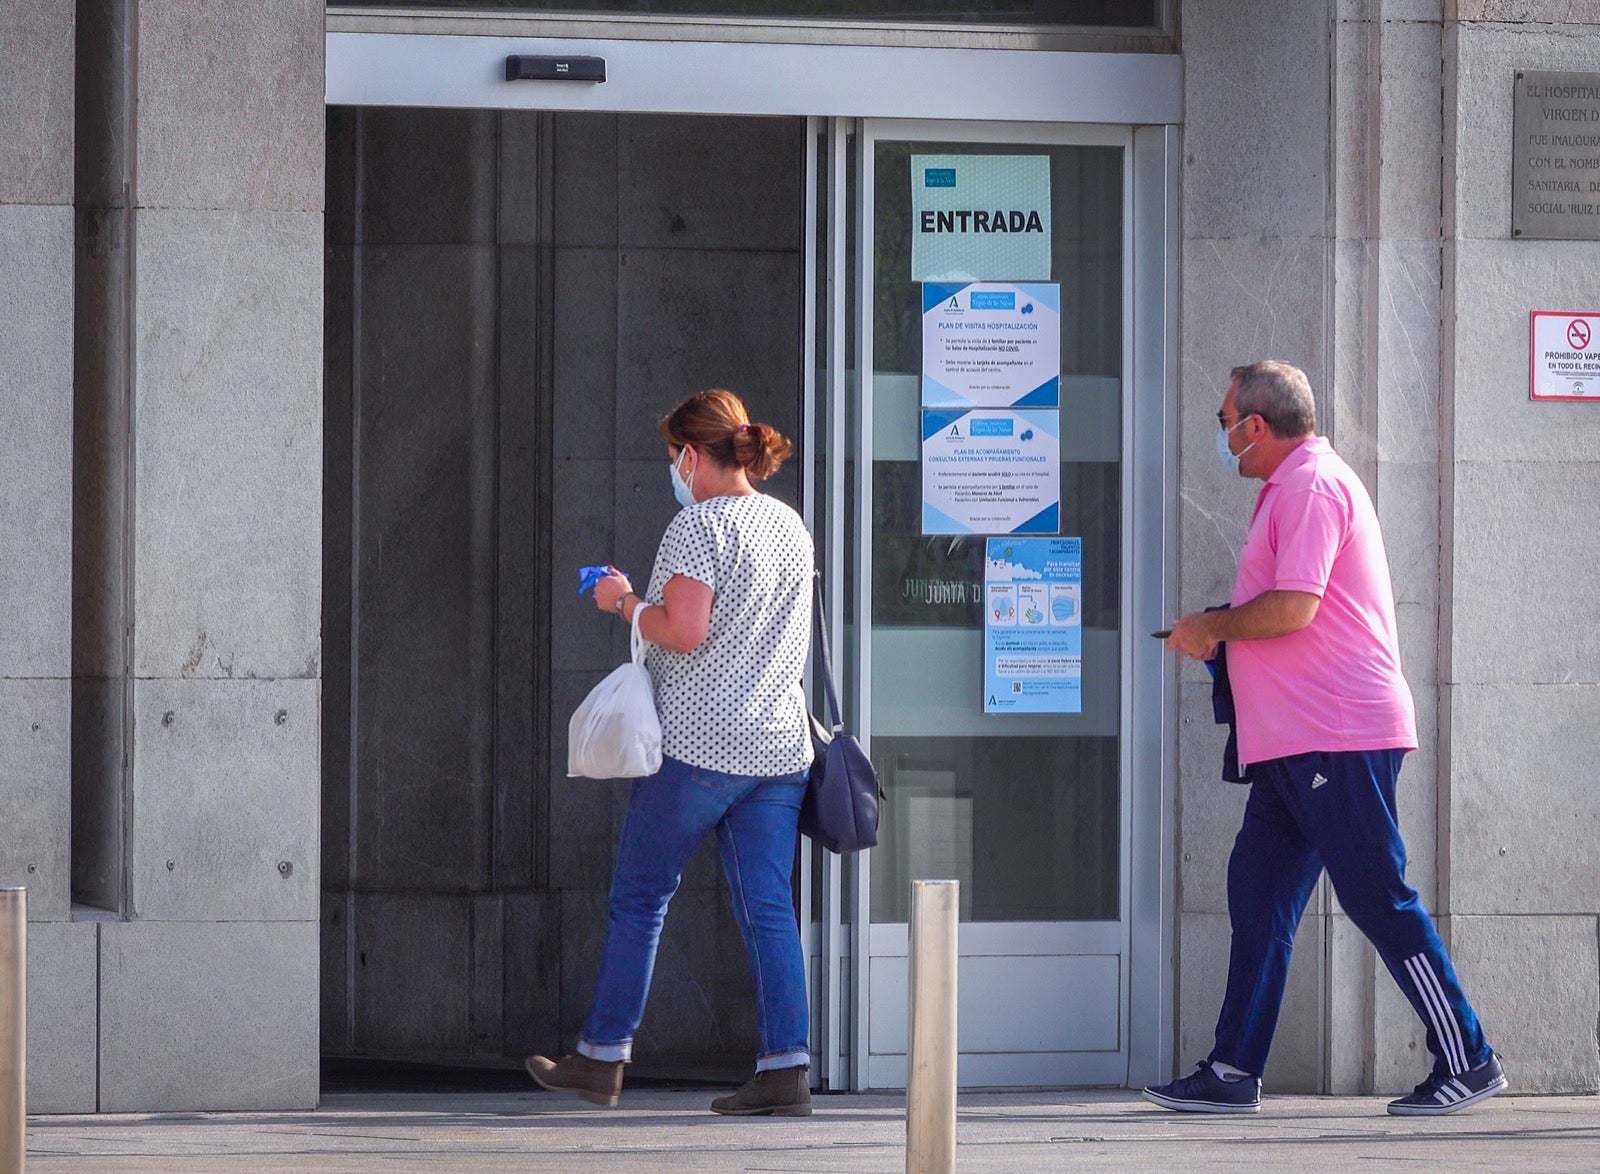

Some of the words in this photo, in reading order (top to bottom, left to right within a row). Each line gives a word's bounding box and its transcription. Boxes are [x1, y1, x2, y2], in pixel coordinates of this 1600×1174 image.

[1545, 86, 1600, 99] HOSPITAL
[1543, 108, 1587, 121] VIRGEN
[1529, 135, 1548, 146] FUE
[1528, 158, 1551, 168] CON
[1554, 158, 1566, 168] EL
[1528, 180, 1580, 192] SANITARIA
[1528, 204, 1565, 214] SOCIAL
[921, 210, 1044, 232] ENTRADA
[987, 322, 1038, 330] HOSPITALIZACIÓN
[925, 584, 966, 604] JUNTA
[972, 584, 982, 604] D
